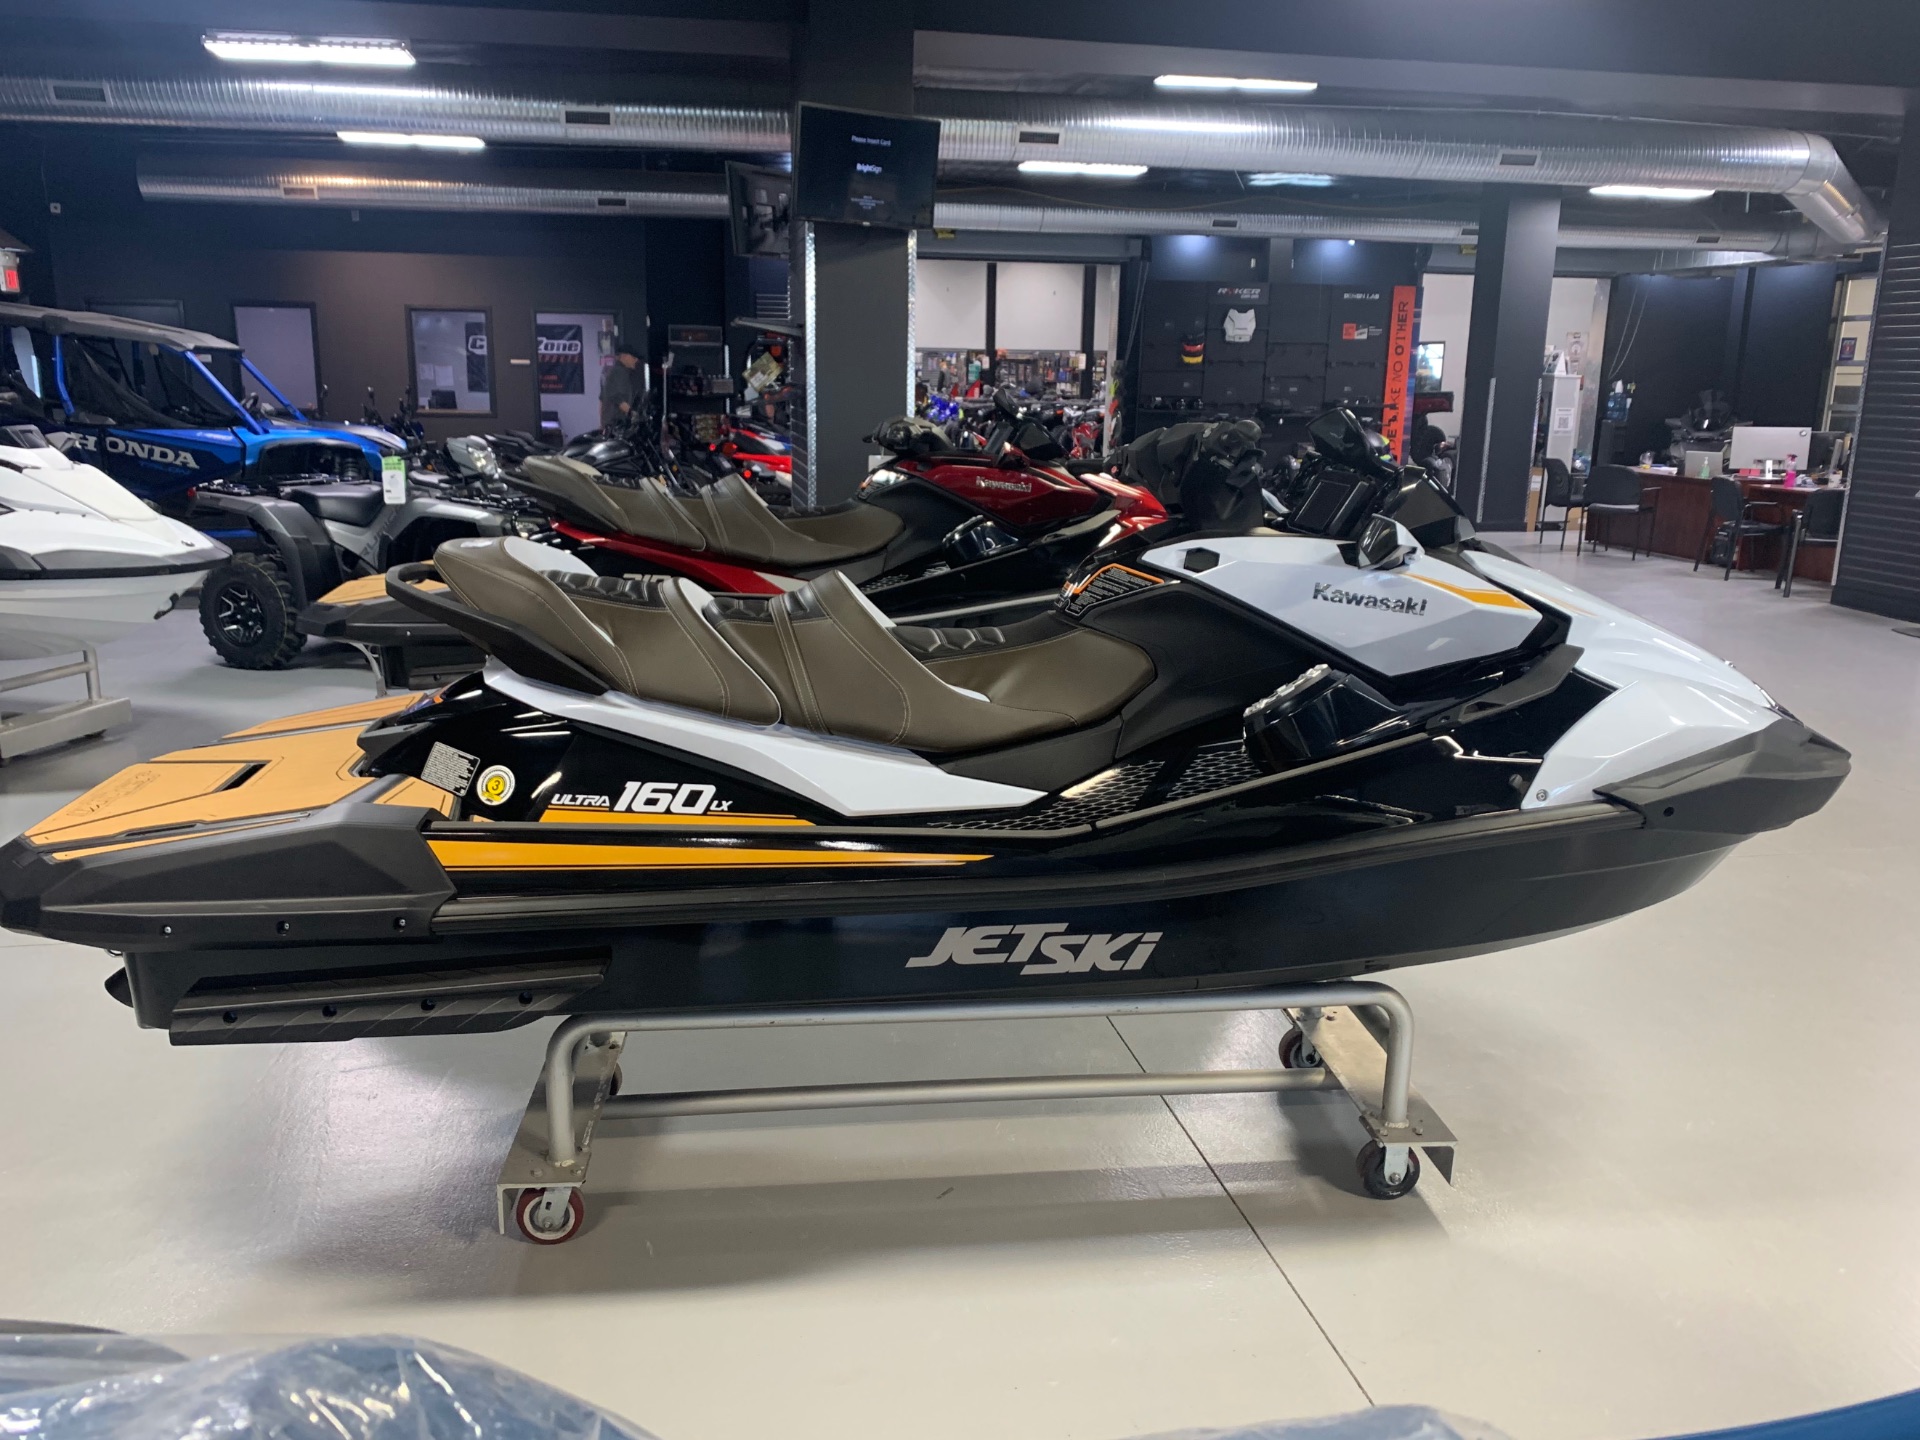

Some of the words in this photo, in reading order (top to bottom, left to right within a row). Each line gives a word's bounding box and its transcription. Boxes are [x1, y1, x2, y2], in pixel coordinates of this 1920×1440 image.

[851, 135, 866, 144] Please
[867, 137, 879, 145] Insert
[880, 138, 891, 147] Card
[856, 162, 882, 174] BrightSign
[1394, 301, 1409, 356] OTHER
[1393, 360, 1403, 382] NO
[70, 431, 200, 470] HONDA
[976, 476, 1032, 493] Kawasaki
[1312, 582, 1428, 616] Kawasaki
[491, 779, 501, 791] 3
[550, 793, 611, 807] ULTRA
[613, 780, 717, 815] 160
[709, 800, 733, 812] LX
